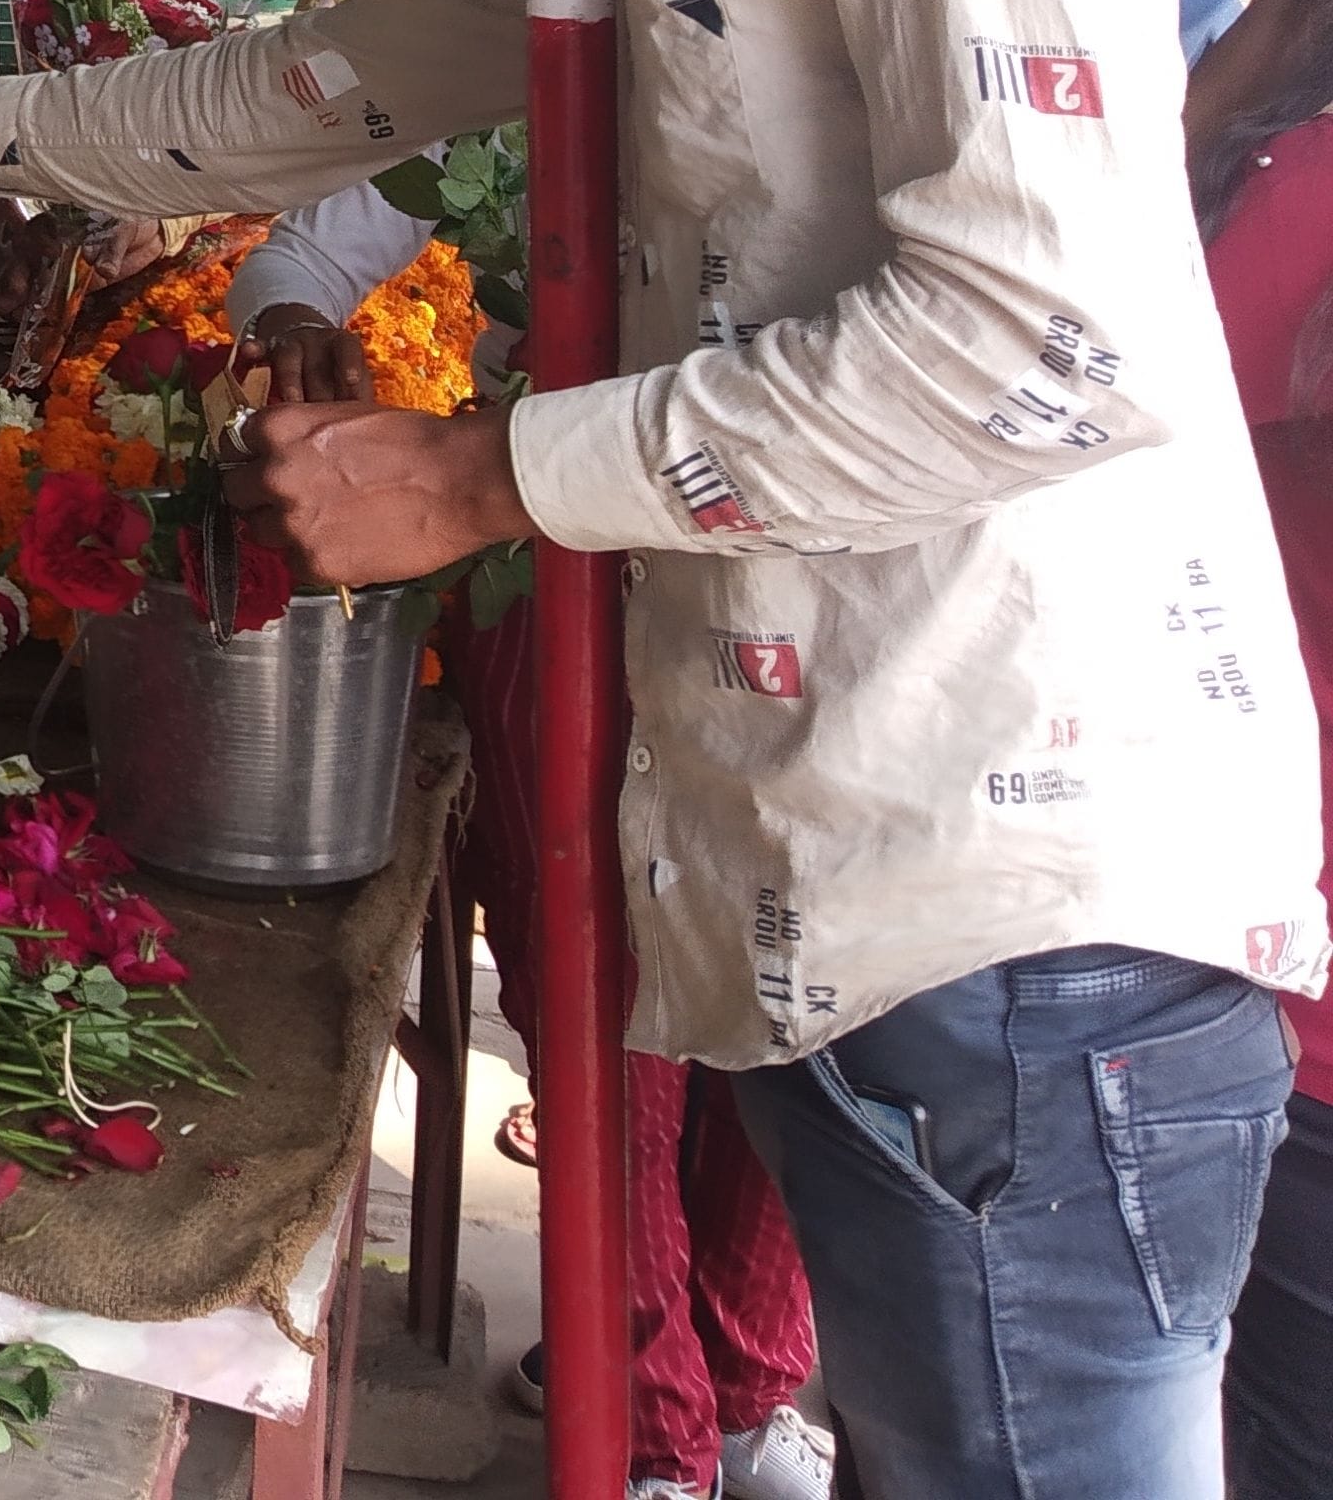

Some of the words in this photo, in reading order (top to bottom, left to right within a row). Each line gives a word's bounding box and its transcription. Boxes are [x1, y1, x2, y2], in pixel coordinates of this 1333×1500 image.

[1051, 62, 1081, 112] 2
[1039, 313, 1084, 379] GROU
[764, 632, 796, 644] SIMPLE
[754, 647, 782, 693] 2
[987, 772, 1028, 805] 69
[753, 887, 776, 951] GROU
[805, 984, 838, 1016] CK
